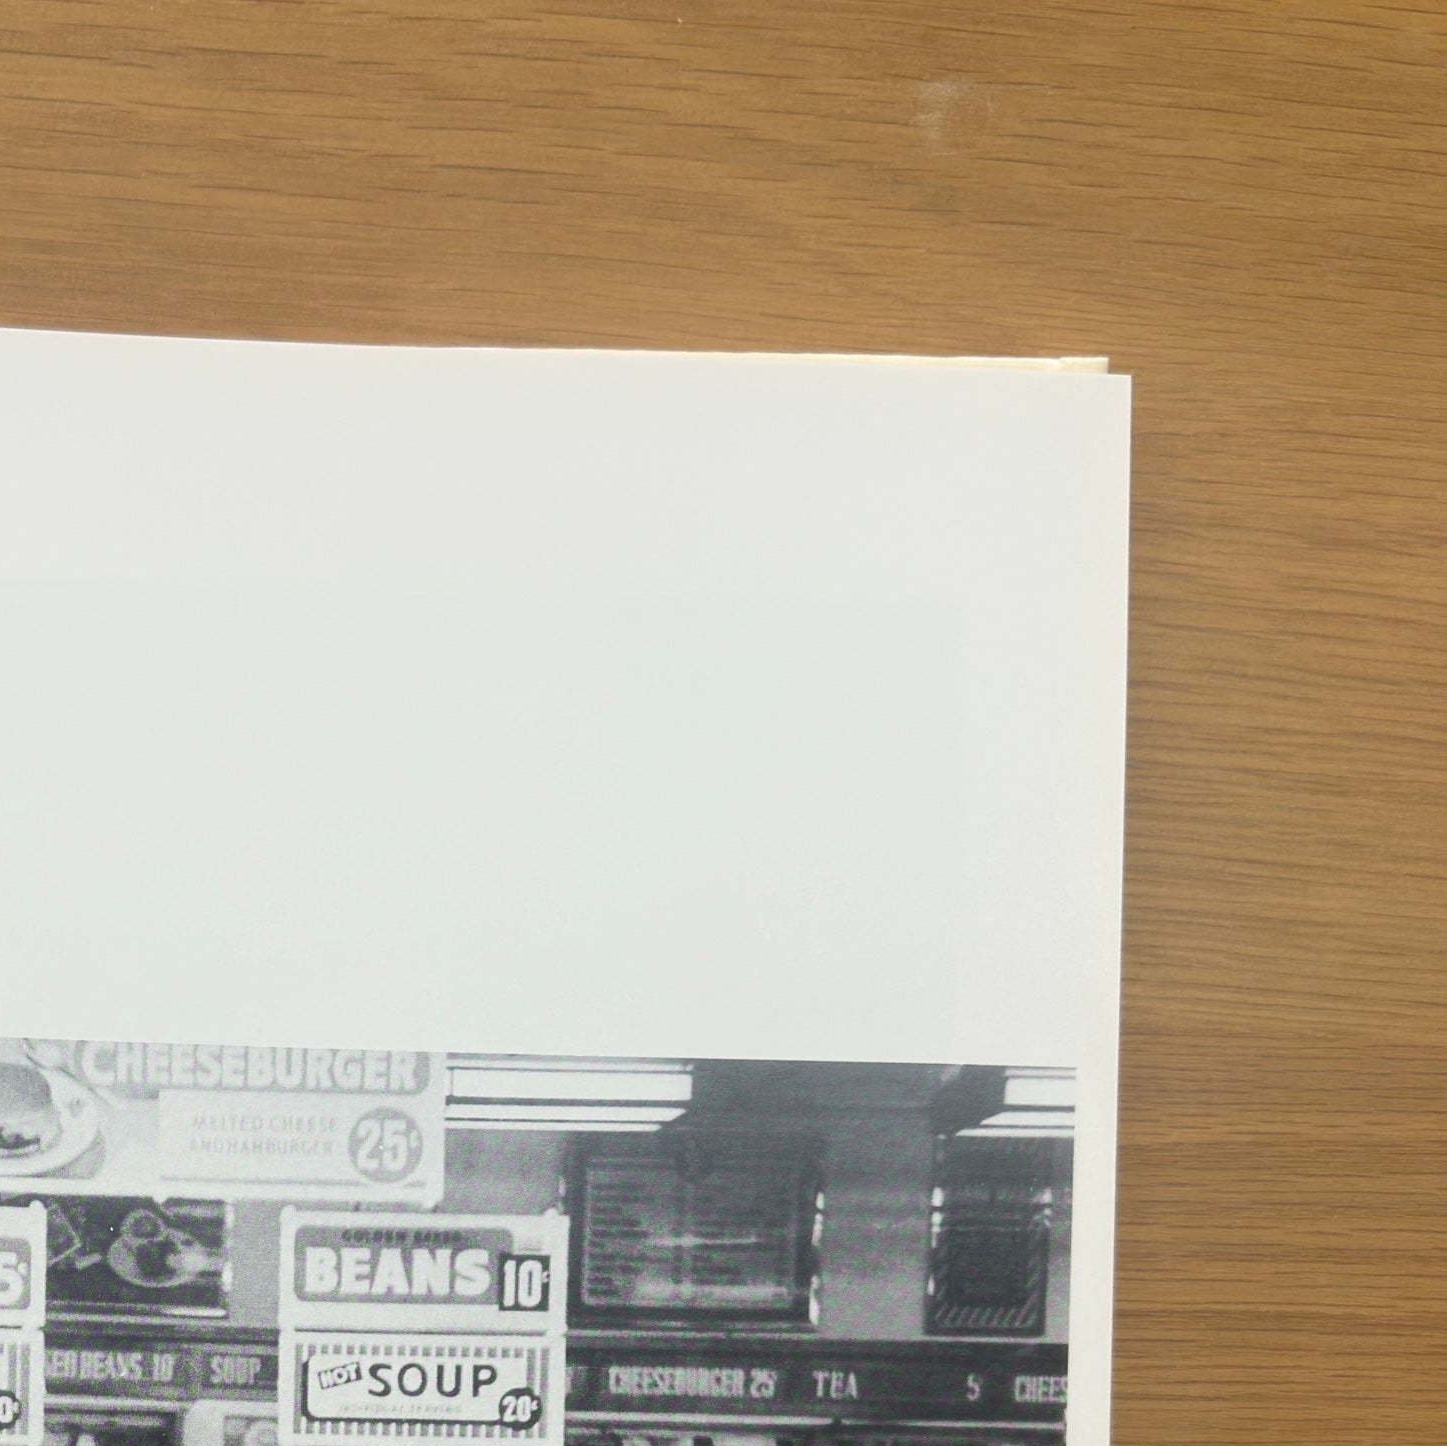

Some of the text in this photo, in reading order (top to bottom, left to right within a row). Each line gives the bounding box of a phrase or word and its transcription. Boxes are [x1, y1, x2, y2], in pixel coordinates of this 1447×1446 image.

[81, 1040, 416, 1092] CHEESEBURGER
[191, 1113, 338, 1134] MELTED CHEESE
[304, 1246, 491, 1296] BEANS
[319, 1362, 498, 1398] HOT SOUP
[609, 1366, 745, 1397] CHEESEBURGER
[812, 1370, 858, 1400] TEA
